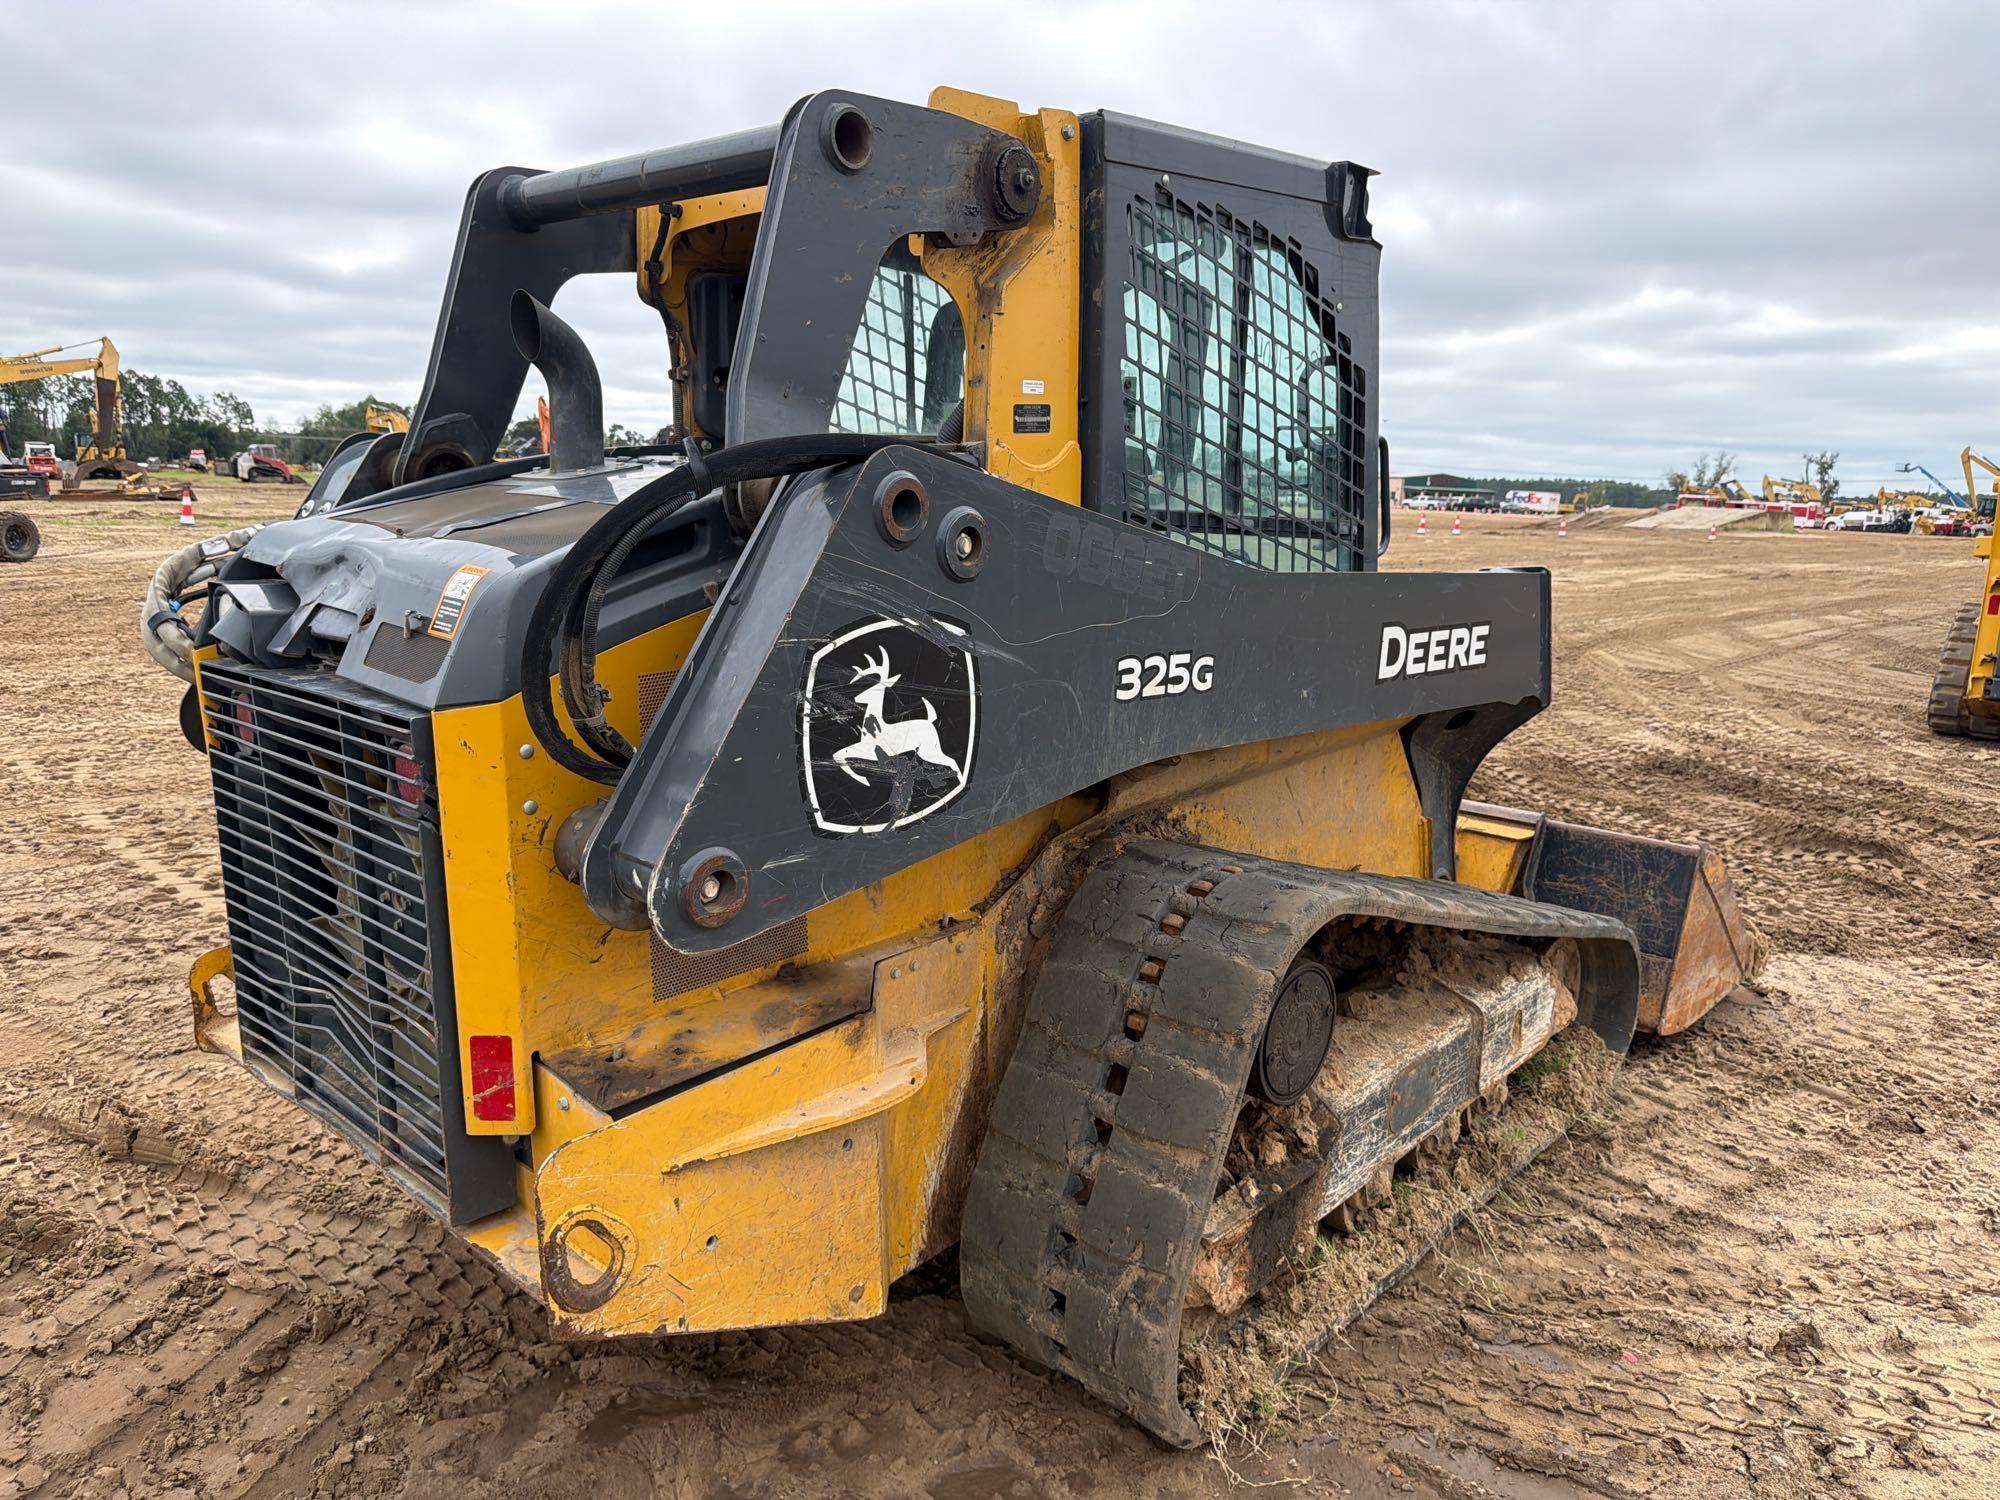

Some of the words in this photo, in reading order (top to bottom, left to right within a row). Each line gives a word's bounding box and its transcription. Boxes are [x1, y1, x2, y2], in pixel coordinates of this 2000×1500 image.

[1512, 491, 1542, 504] FedEx
[1378, 625, 1490, 680] DEERE
[1116, 653, 1215, 700] 325G
